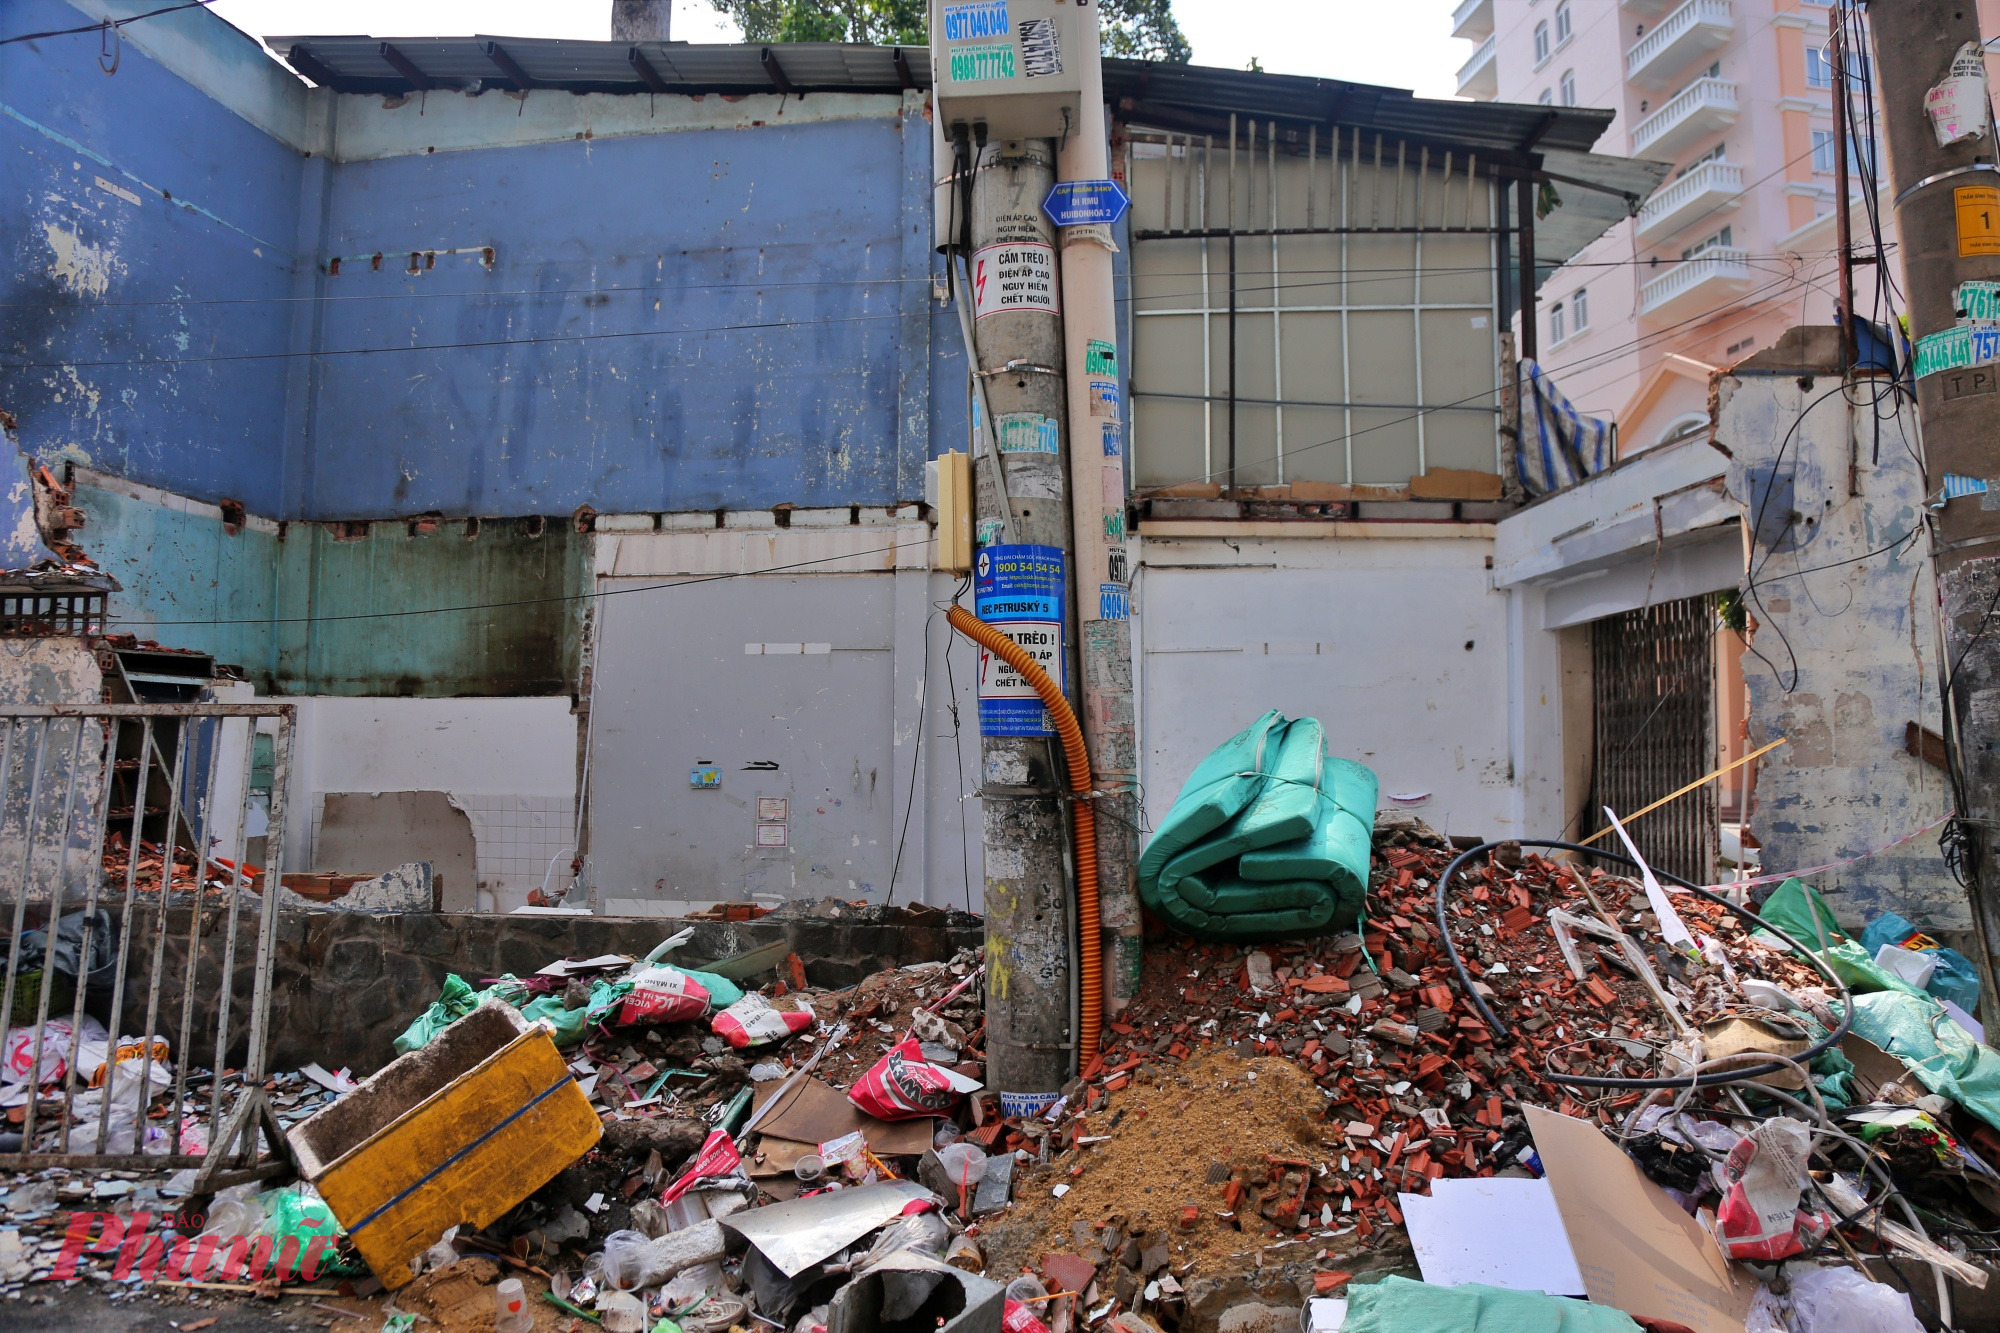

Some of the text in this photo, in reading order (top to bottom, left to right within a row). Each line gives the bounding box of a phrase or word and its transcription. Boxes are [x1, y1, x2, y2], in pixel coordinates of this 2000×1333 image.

[1082, 197, 1099, 205] RMU
[1060, 209, 1111, 219] HUIBONHOA 2
[1980, 211, 1990, 230] 1
[997, 225, 1016, 233] NGUY
[999, 249, 1019, 265] CẤM
[1021, 250, 1044, 265] TRÈO
[998, 267, 1050, 280] ĐIỆN ÁP CAO
[1002, 279, 1048, 292] NGUY HIỂM
[1001, 292, 1050, 305] CHẾT NGƯỜI
[1952, 373, 1986, 393] T P
[995, 562, 1061, 574] 1900 54 54 54
[981, 600, 1049, 615] REC PETRUSKÝ 5
[1017, 631, 1048, 645] TRÈO
[1039, 649, 1053, 660] ÁP
[998, 665, 1020, 674] NGU
[995, 676, 1017, 687] CHẾT
